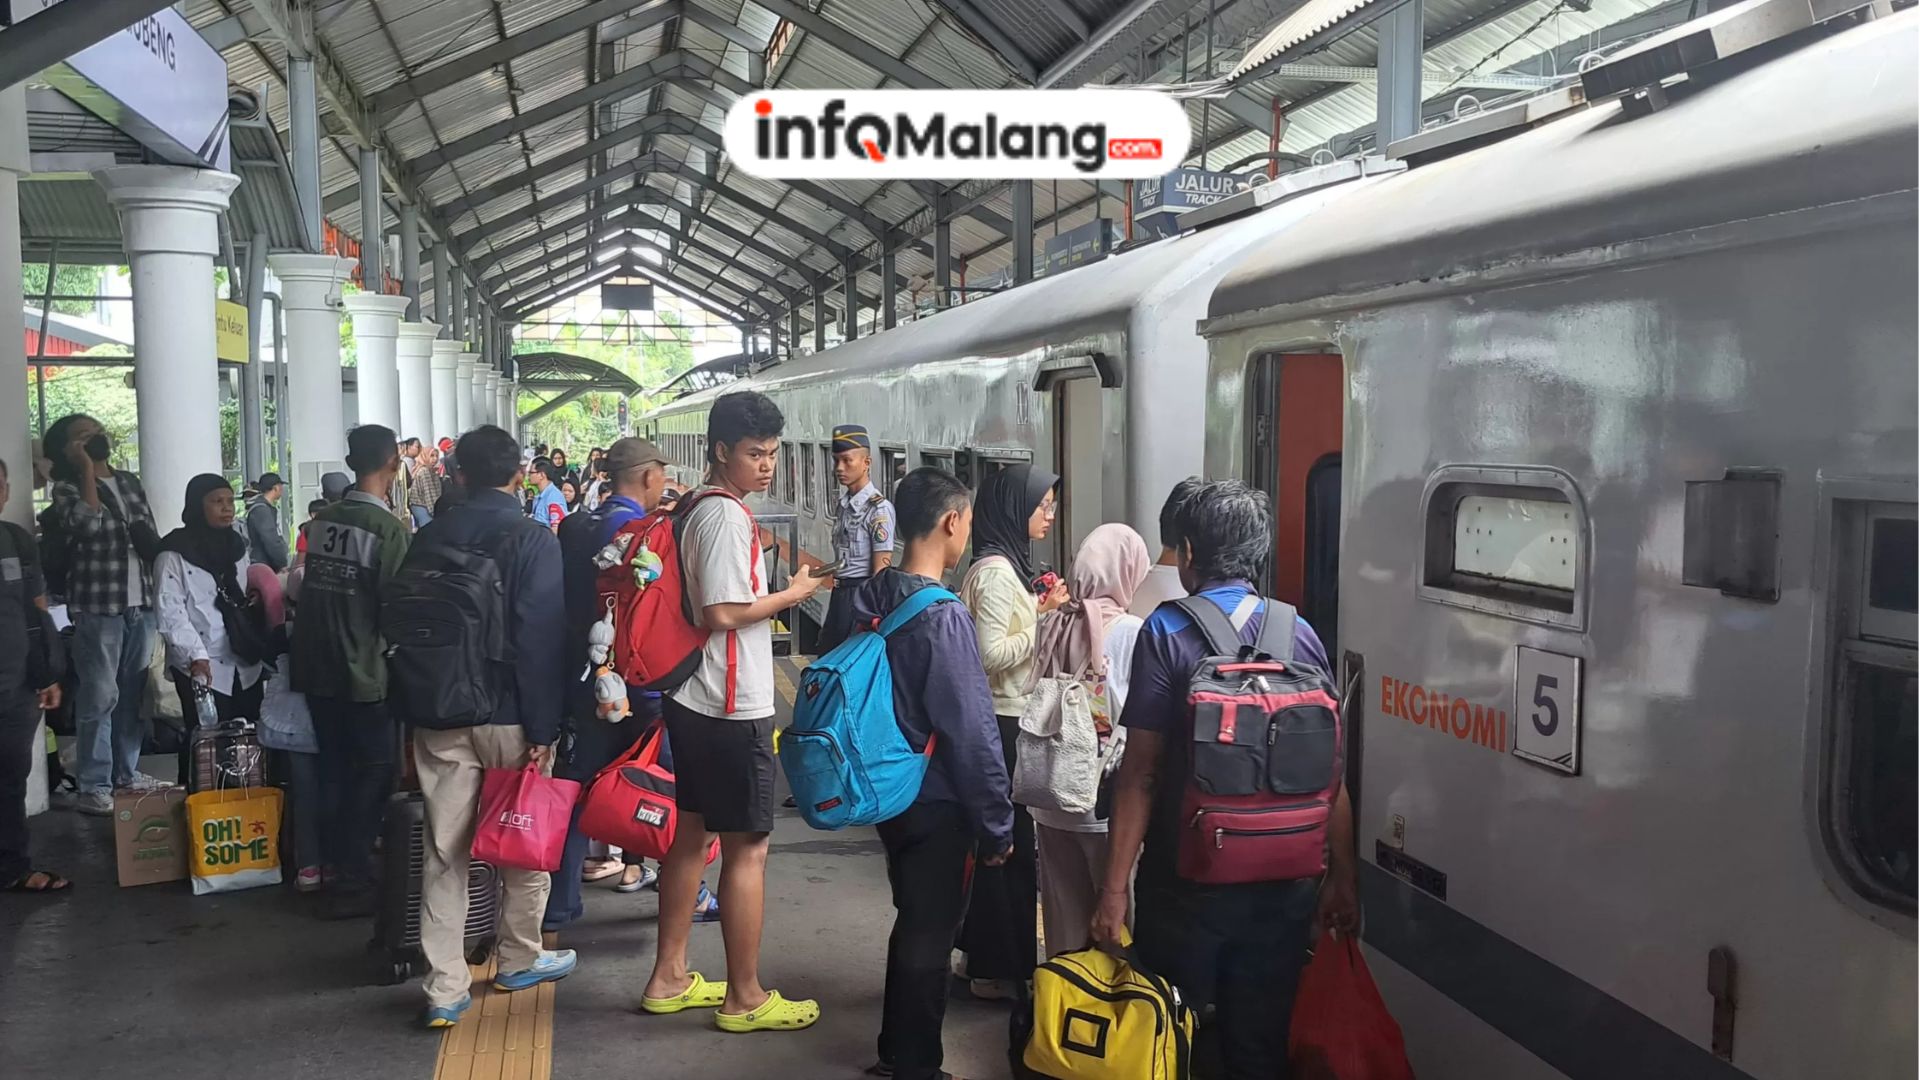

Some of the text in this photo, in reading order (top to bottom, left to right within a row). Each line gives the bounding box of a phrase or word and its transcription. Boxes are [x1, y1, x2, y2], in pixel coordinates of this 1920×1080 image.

[126, 16, 176, 72] UBENG
[1175, 174, 1234, 194] JALUR
[323, 526, 351, 556] 31
[1381, 675, 1506, 753] EKONOMI
[1531, 673, 1559, 737] 5
[203, 816, 242, 843] OH!
[204, 836, 270, 866] SOME
